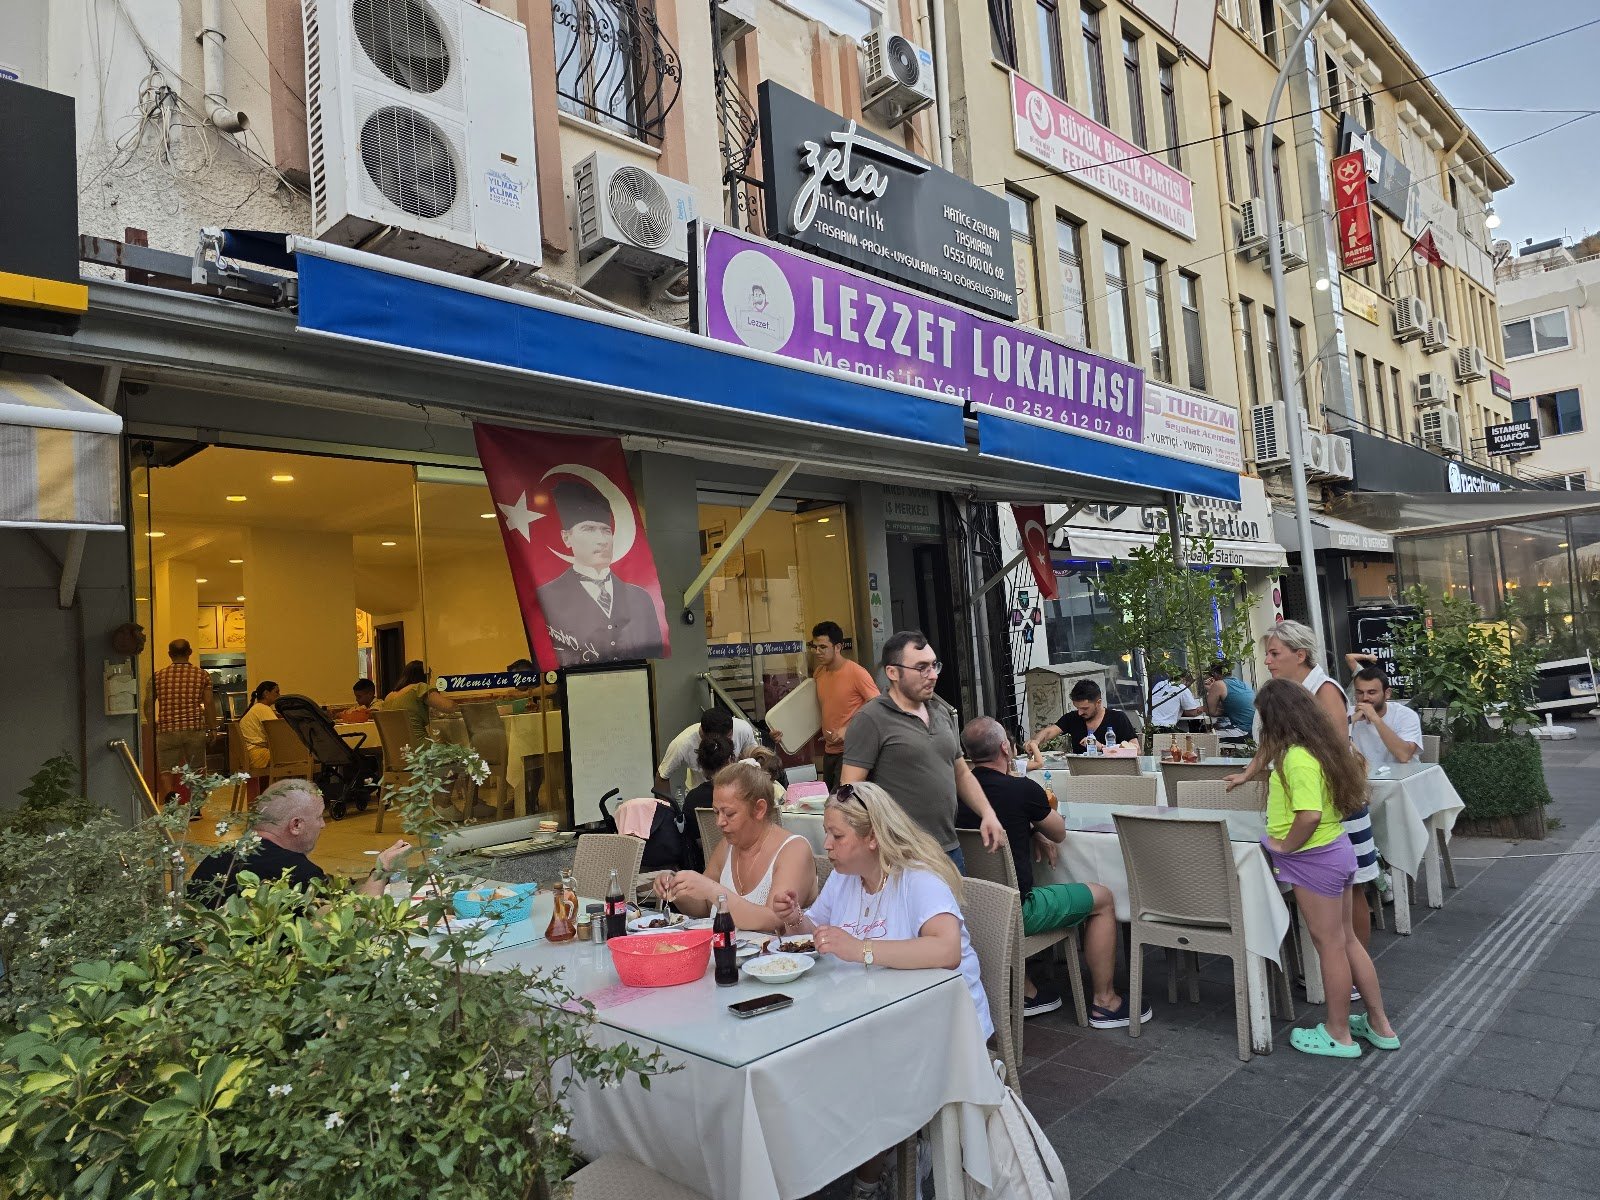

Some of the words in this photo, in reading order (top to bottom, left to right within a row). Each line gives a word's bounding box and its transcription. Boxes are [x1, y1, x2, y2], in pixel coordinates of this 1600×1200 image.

[1059, 113, 1102, 158] BÜYÜK
[1104, 140, 1142, 181] BİRLİK
[1144, 163, 1183, 204] PARTİSİ
[488, 176, 519, 193] YILMAZ
[794, 119, 932, 232] zeta
[1063, 147, 1105, 185] FETHİYE
[1108, 169, 1130, 199] İLÇE
[1133, 187, 1186, 228] BAŞKANLIĞI
[943, 204, 971, 227] HATİCE
[972, 218, 1000, 242] ZEYLAN
[954, 229, 993, 258] TAŞKIRAN
[943, 244, 950, 258] 0
[950, 246, 967, 265] 553
[967, 253, 983, 272] 080
[983, 260, 994, 276] 06
[994, 266, 1005, 281] 62
[811, 276, 956, 368] LEZZET
[973, 327, 1134, 417] LOKANTASI
[933, 377, 971, 401] Yeri
[1005, 396, 1015, 411] 0
[1022, 400, 1053, 421] 252
[1060, 409, 1089, 428] 612
[1094, 418, 1111, 433] 07
[1116, 424, 1133, 440] 80
[1164, 420, 1201, 437] Seyahat
[1202, 430, 1236, 446] Acentası
[1491, 422, 1531, 436] İSTANBUL
[1494, 430, 1530, 444] KUAFÖR
[1150, 432, 1179, 450] YURTİÇİ
[1183, 439, 1213, 456] YURTDIŞI
[1197, 510, 1260, 539] Station
[1215, 549, 1244, 565] Station
[450, 675, 508, 688] Memiş'in
[512, 673, 537, 686] Yeri
[1385, 661, 1396, 675] İŞ
